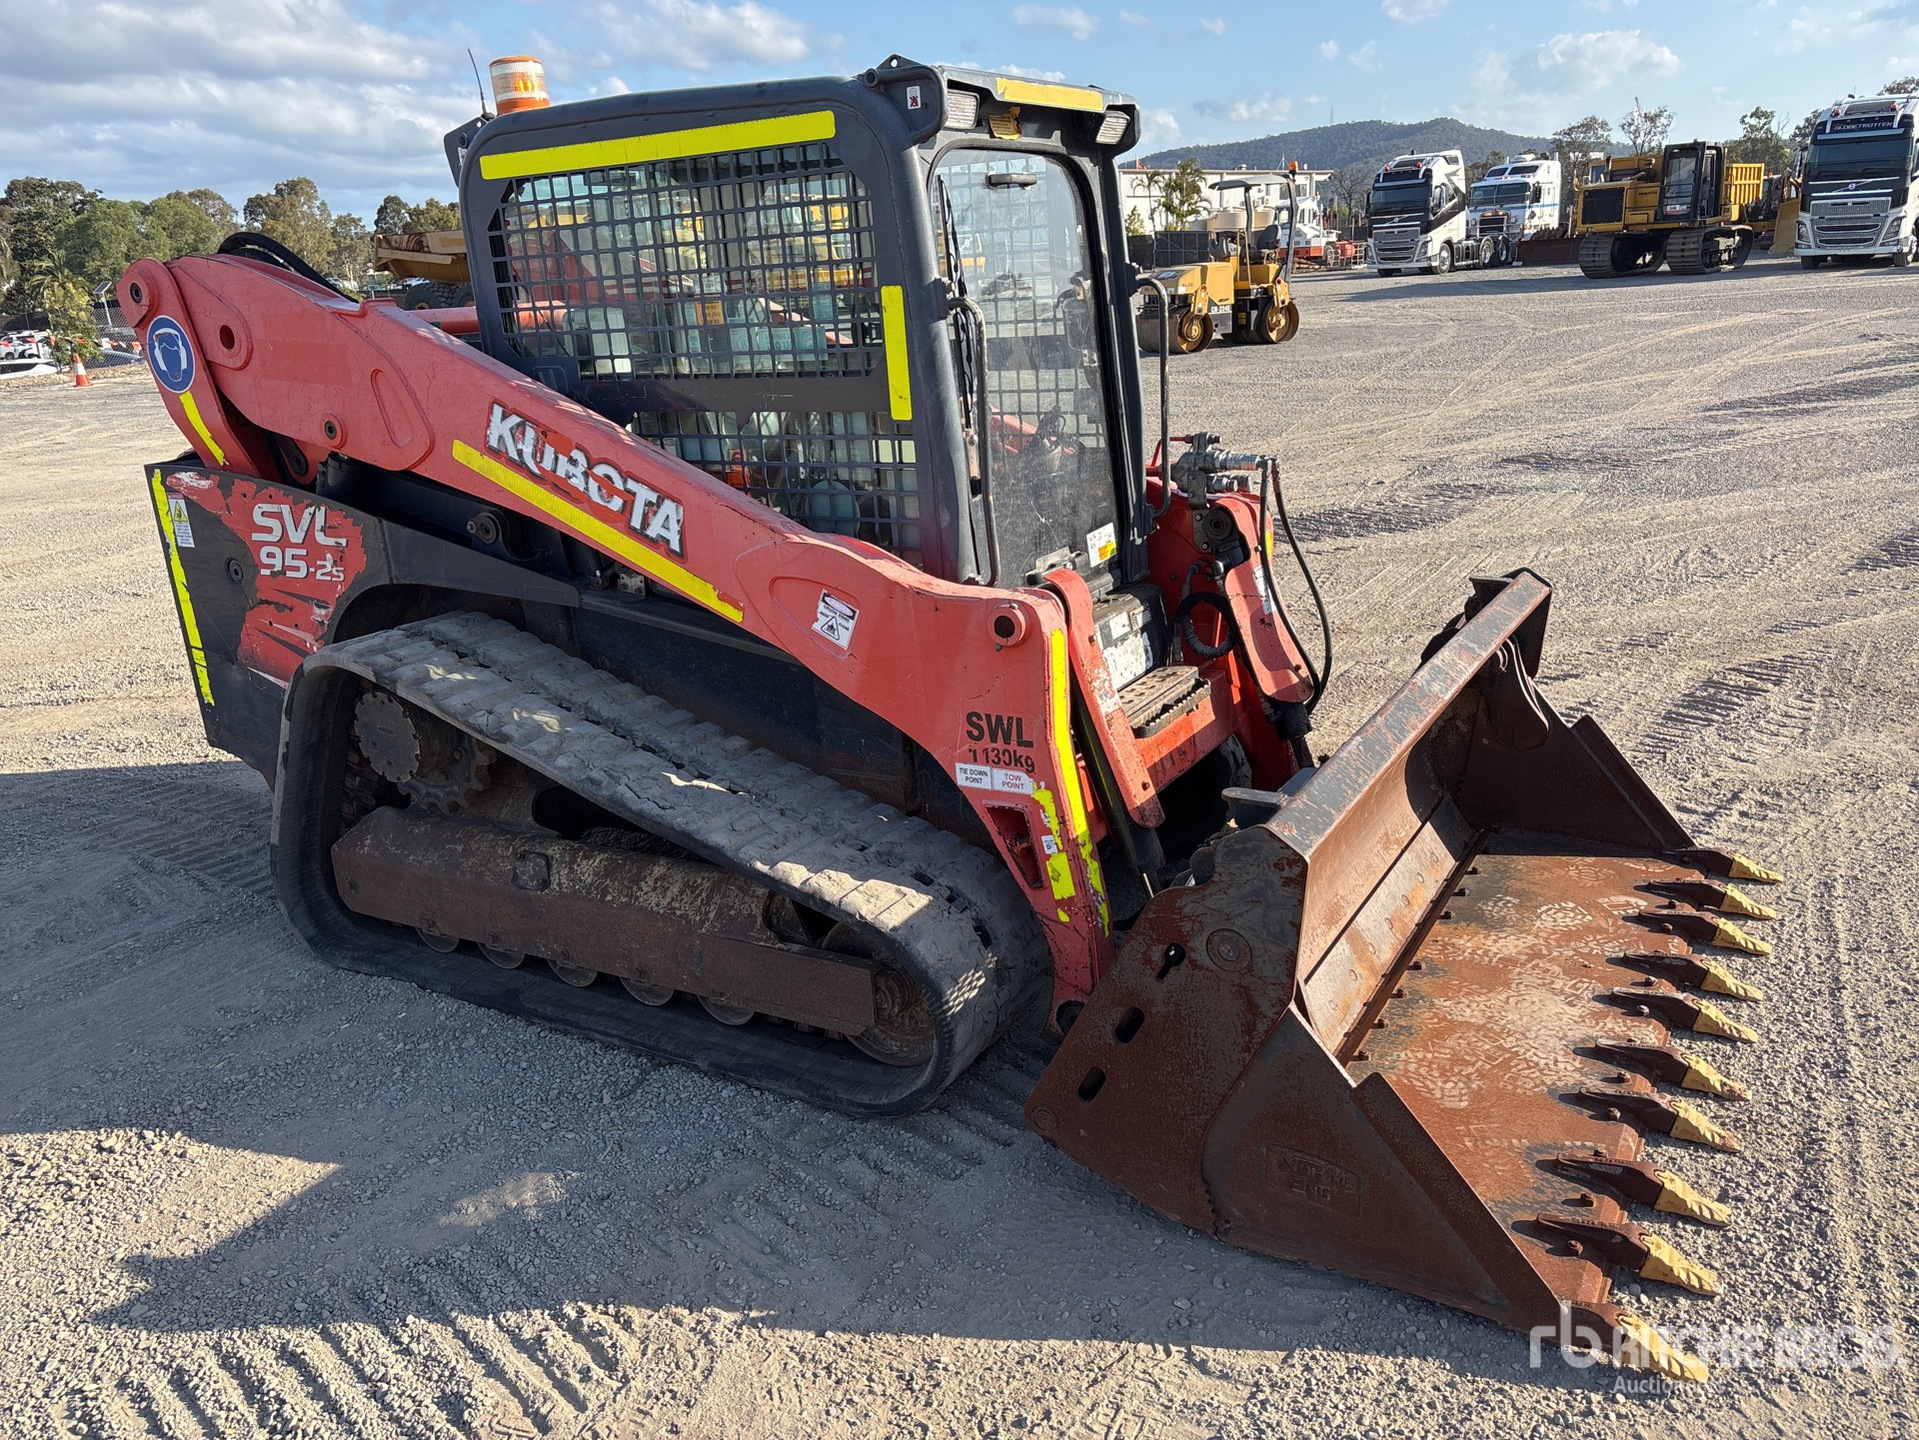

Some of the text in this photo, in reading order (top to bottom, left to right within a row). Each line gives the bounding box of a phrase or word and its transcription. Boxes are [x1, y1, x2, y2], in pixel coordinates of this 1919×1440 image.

[1833, 121, 1893, 131] GLOBETROTTER
[487, 403, 684, 554] KUBOTA
[252, 503, 347, 547] SVL
[965, 711, 1034, 748] SWL
[959, 767, 988, 777] TIE DOWN
[1004, 771, 1021, 781] TOW
[965, 775, 983, 784] POINT
[1002, 780, 1025, 790] POINT
